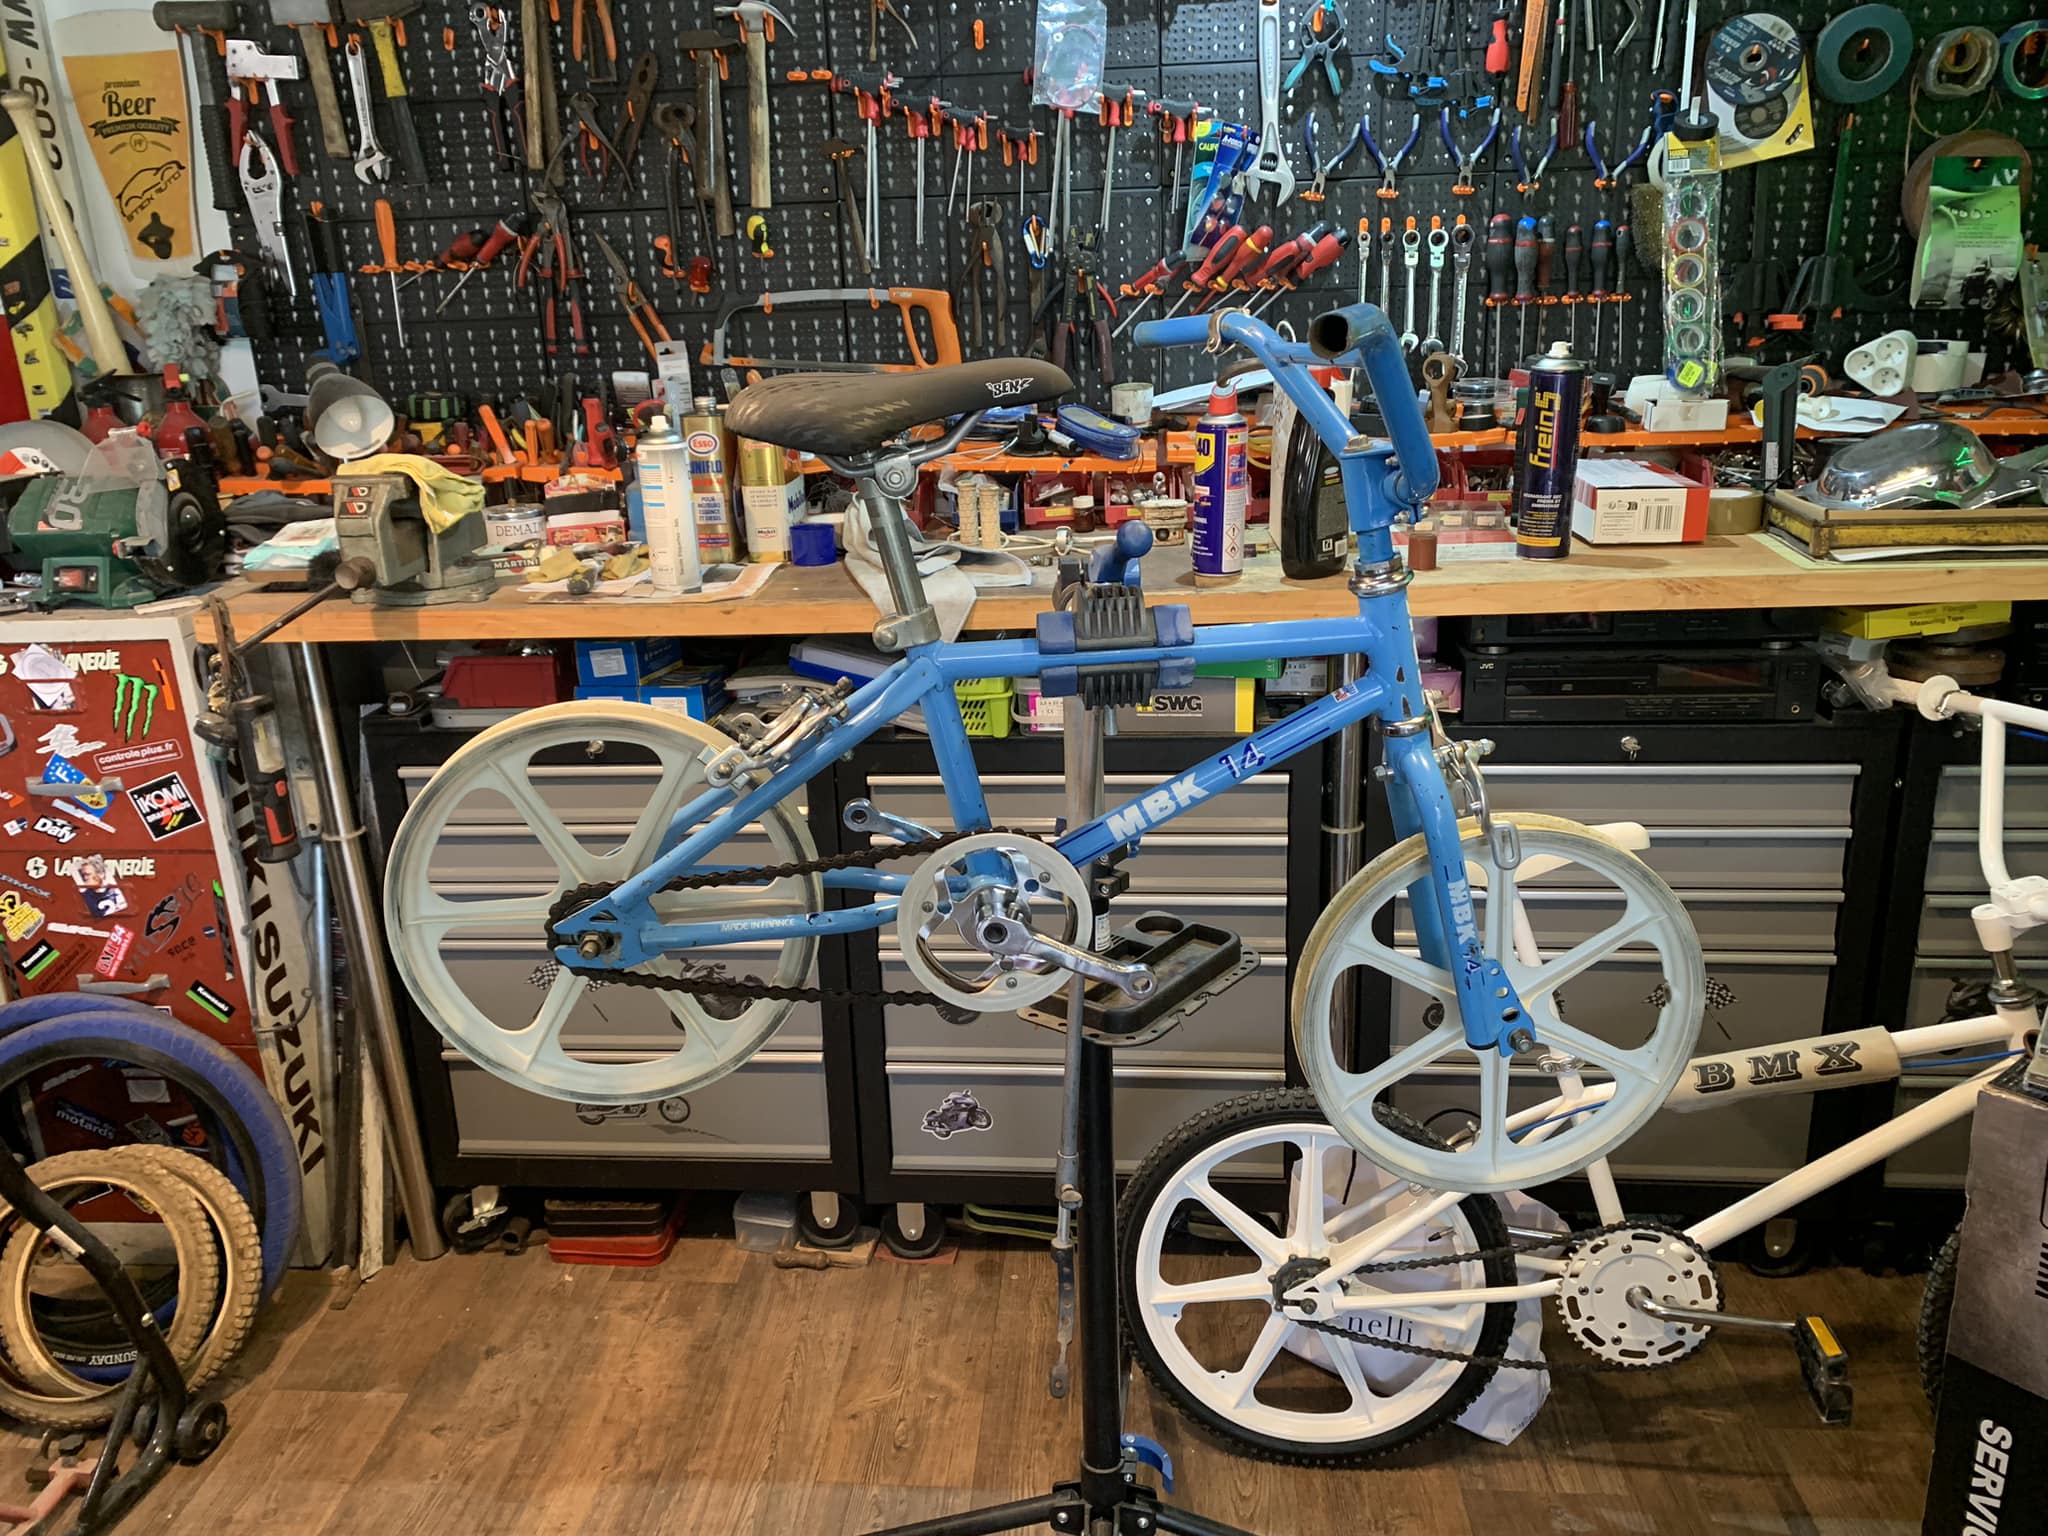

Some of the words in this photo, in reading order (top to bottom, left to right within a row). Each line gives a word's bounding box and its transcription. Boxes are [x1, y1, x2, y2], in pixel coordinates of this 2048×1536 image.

[102, 90, 156, 117] Beer
[493, 558, 540, 570] MARTINI
[1479, 662, 1494, 670] JVC
[1154, 695, 1202, 711] SWG
[1105, 772, 1210, 842] MBK
[1219, 741, 1266, 779] 14
[33, 817, 77, 844] Dafy
[1447, 878, 1477, 945] MBK
[720, 923, 749, 933] MADE
[760, 918, 795, 930] FRANCE
[56, 1109, 115, 1140] motards
[88, 1350, 138, 1366] SUNDAY
